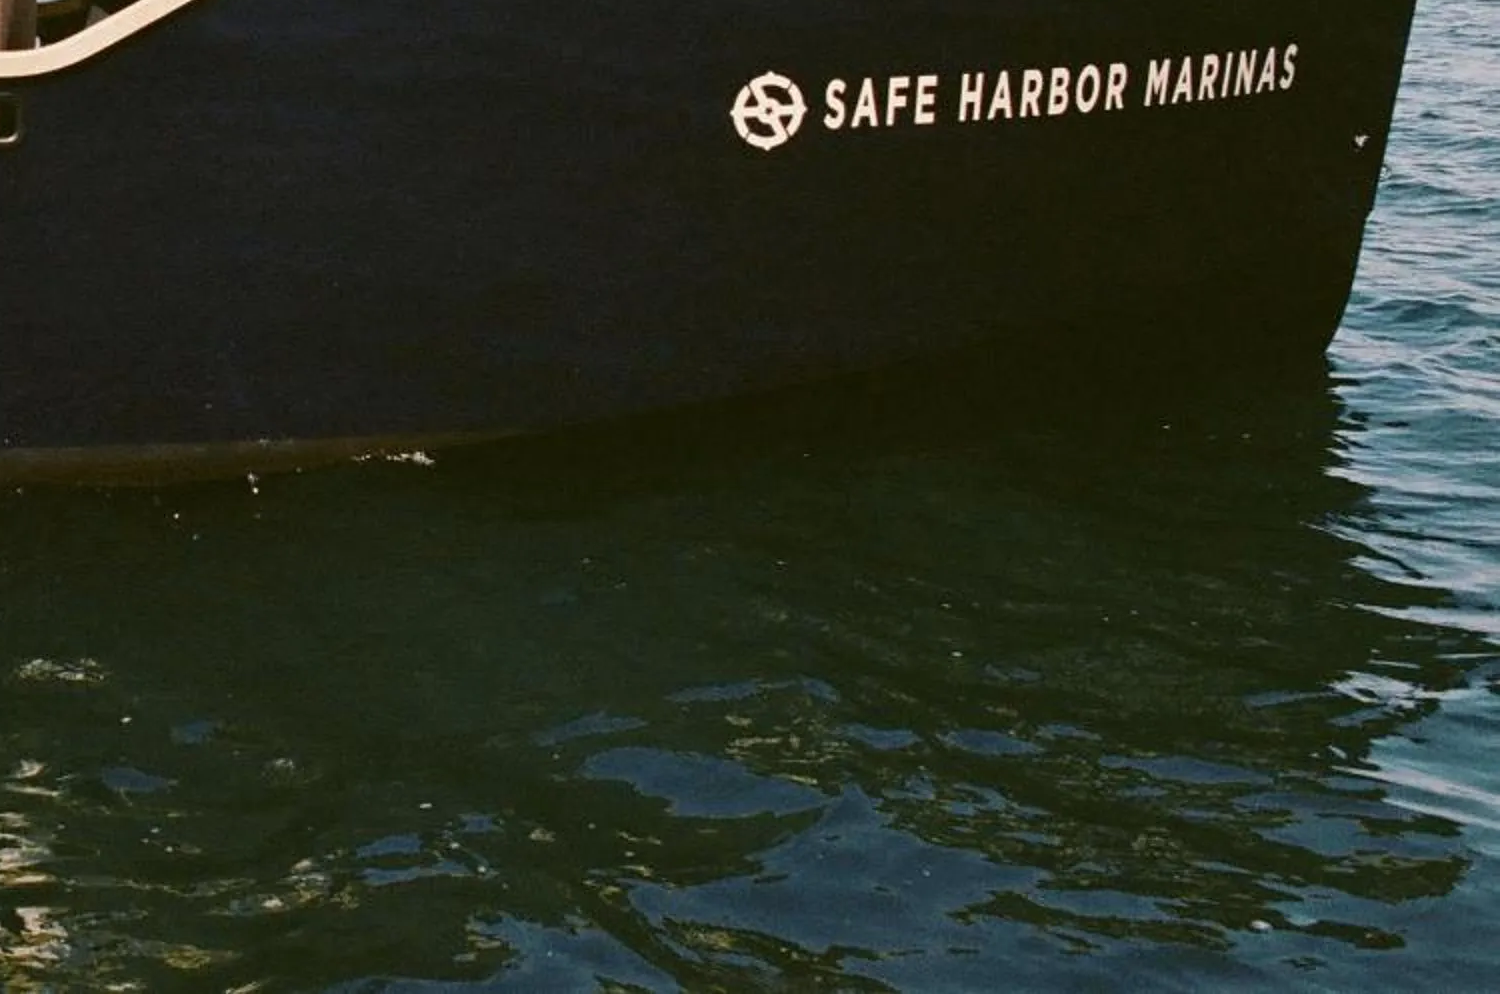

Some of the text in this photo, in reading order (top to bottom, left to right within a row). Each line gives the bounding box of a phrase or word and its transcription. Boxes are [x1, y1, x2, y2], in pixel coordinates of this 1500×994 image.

[823, 43, 1299, 130] SAFE HARBOR MARINAS
